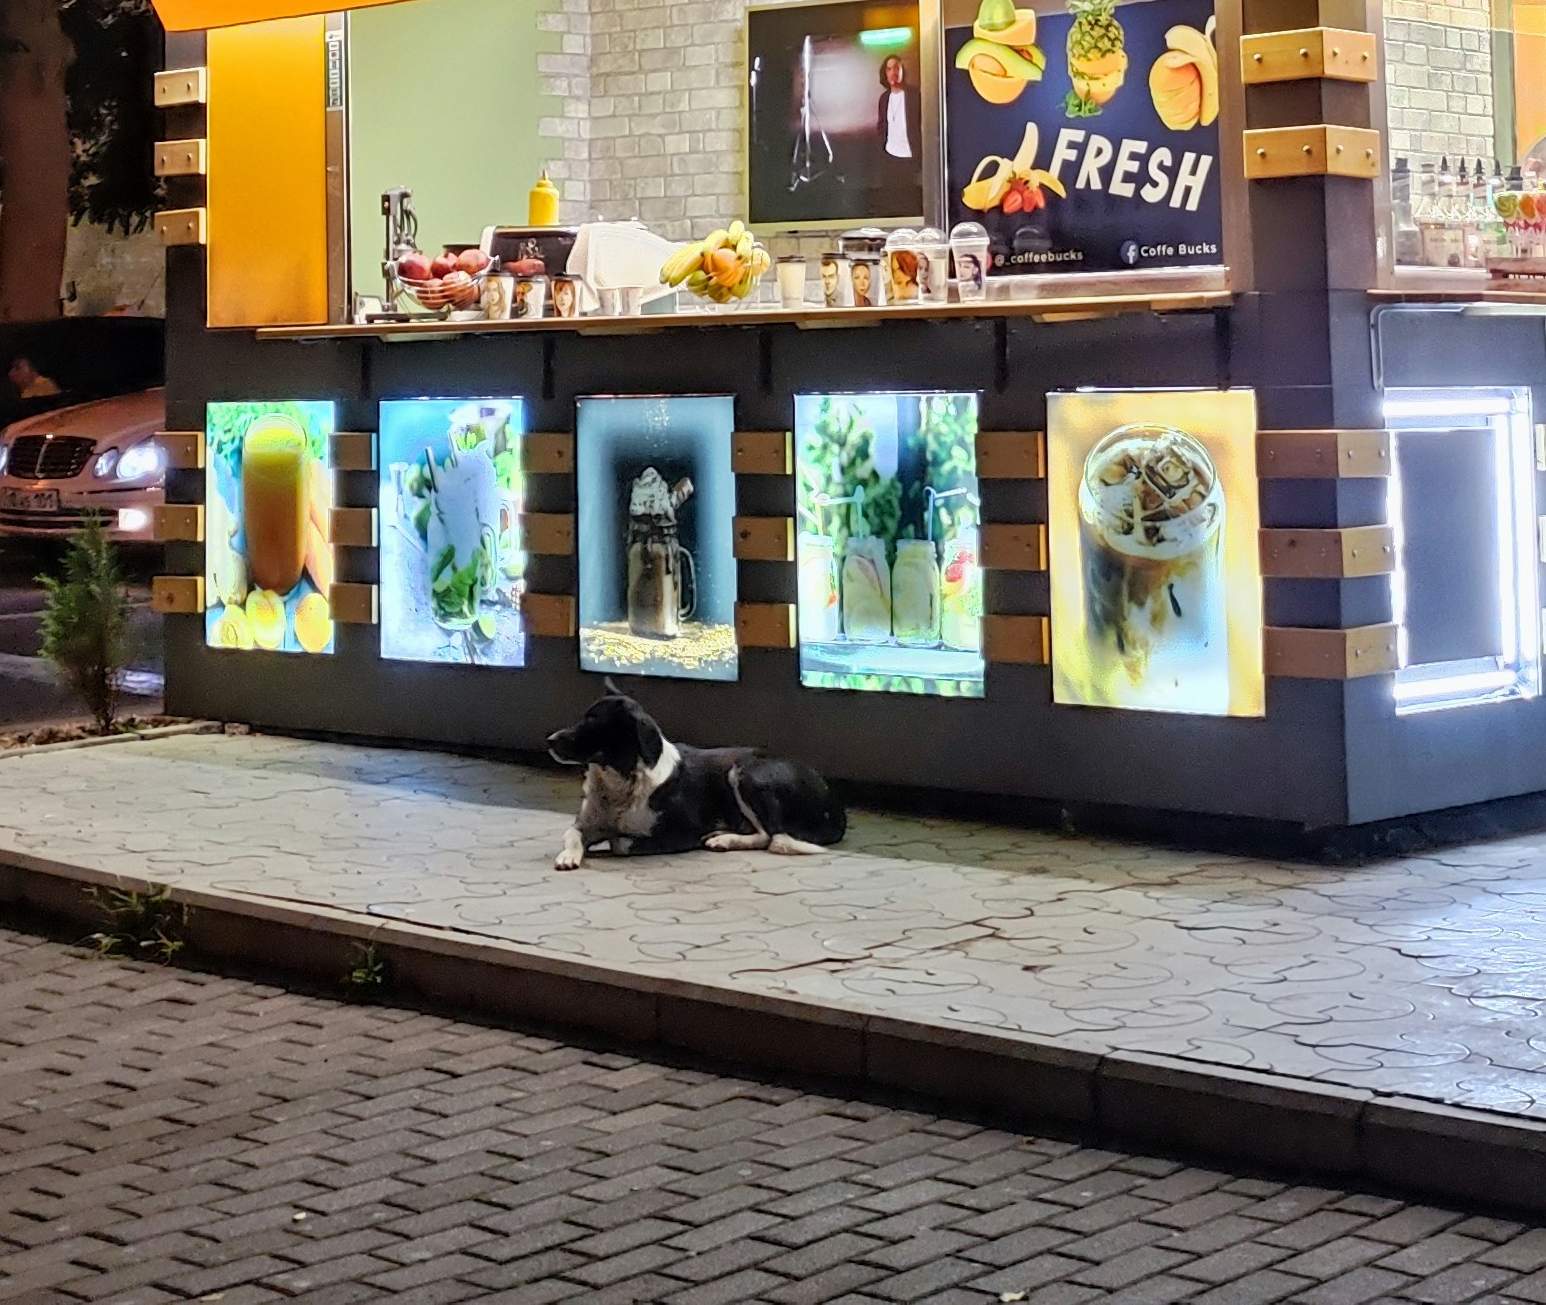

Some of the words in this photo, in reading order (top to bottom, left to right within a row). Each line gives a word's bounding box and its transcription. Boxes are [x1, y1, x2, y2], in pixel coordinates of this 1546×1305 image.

[1051, 128, 1213, 211] FRESH
[1140, 245, 1174, 257] Coffe
[1178, 242, 1217, 255] Bucks
